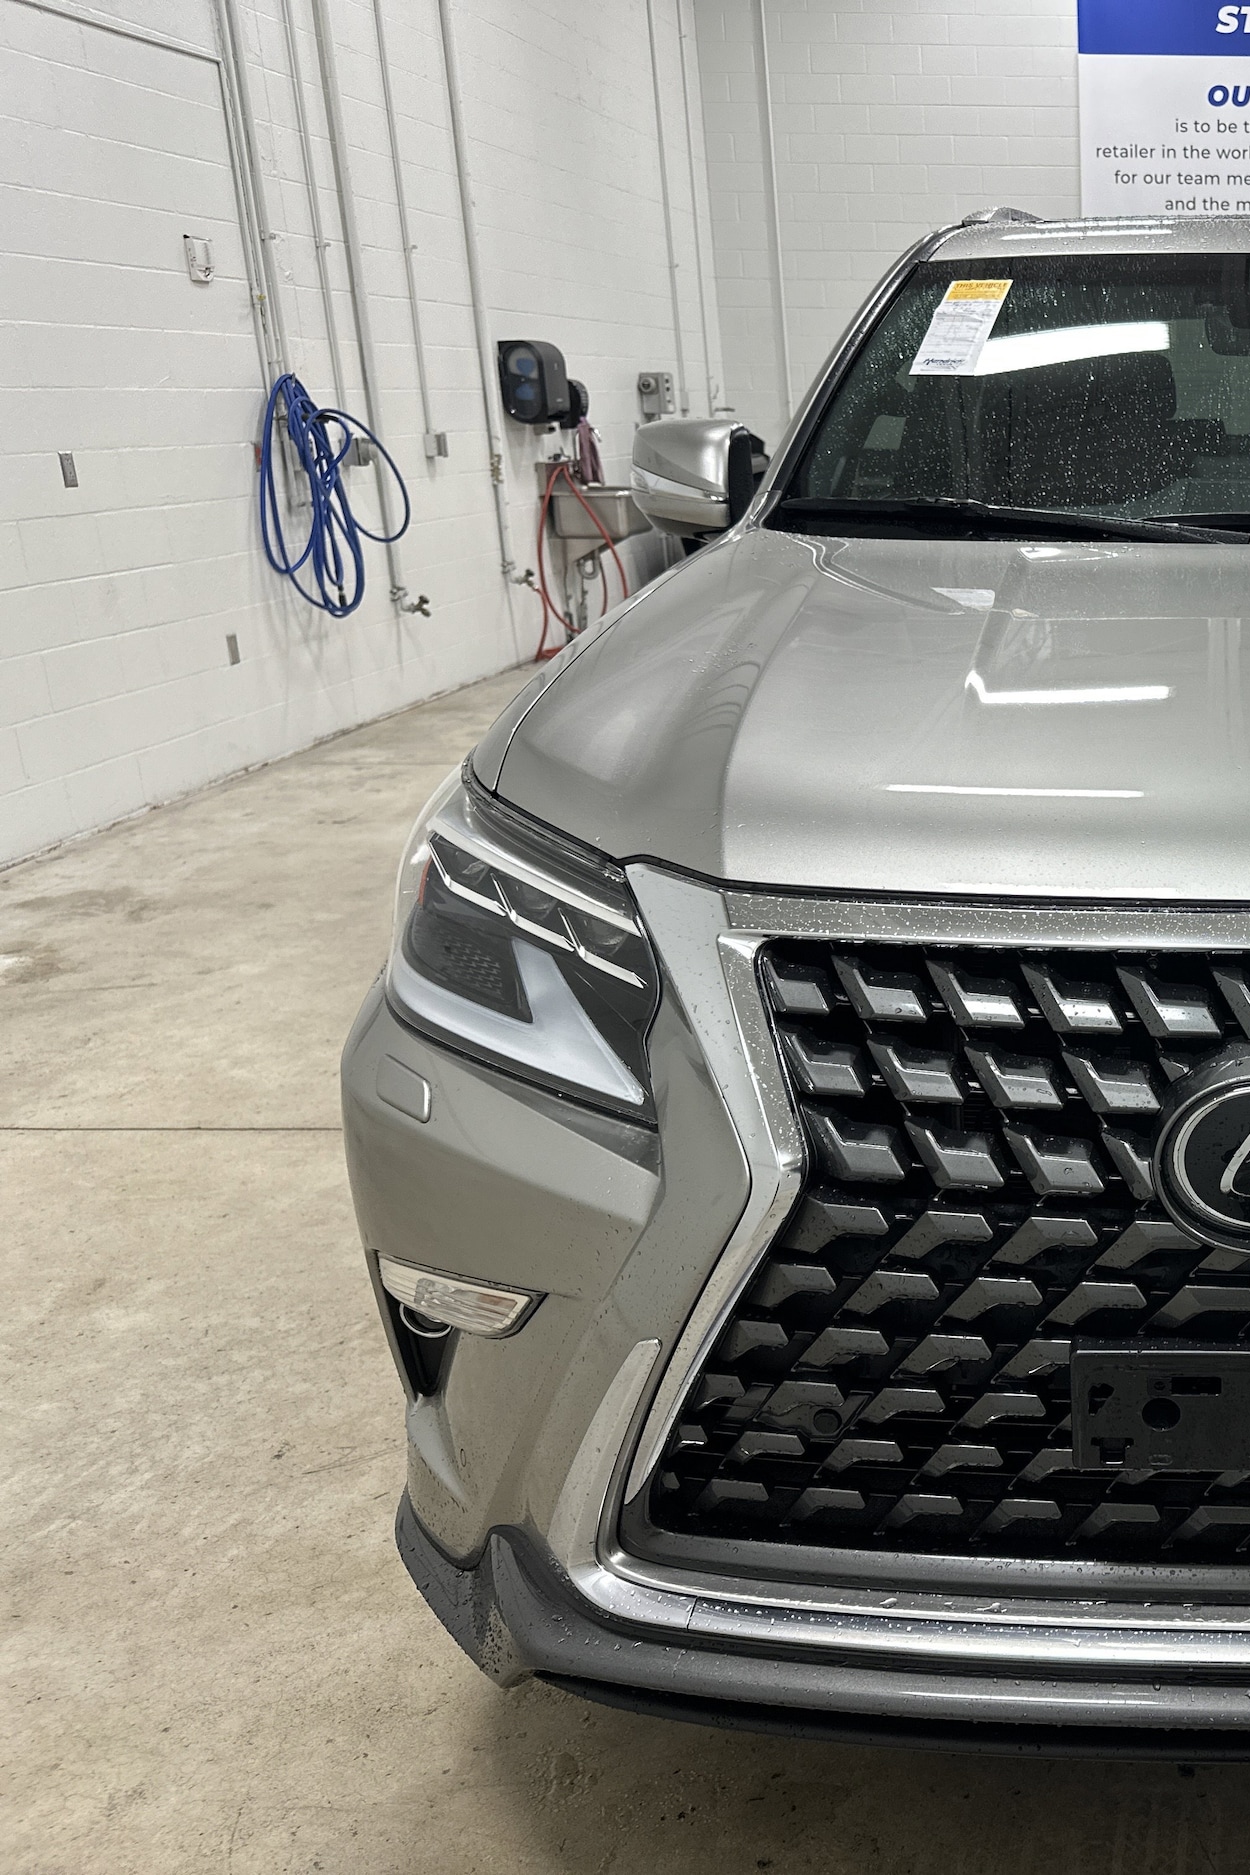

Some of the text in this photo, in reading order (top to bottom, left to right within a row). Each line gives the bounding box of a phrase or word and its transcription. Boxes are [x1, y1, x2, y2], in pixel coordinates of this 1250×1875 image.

[1175, 119, 1188, 133] is
[1194, 120, 1211, 133] to
[1217, 119, 1238, 133] be
[1096, 144, 1156, 159] retailer
[1162, 145, 1177, 159] in
[1183, 145, 1211, 159] the
[1114, 169, 1138, 185] for
[1143, 173, 1172, 185] our
[1177, 173, 1220, 186] team
[1165, 197, 1196, 211] and
[1202, 197, 1230, 211] the
